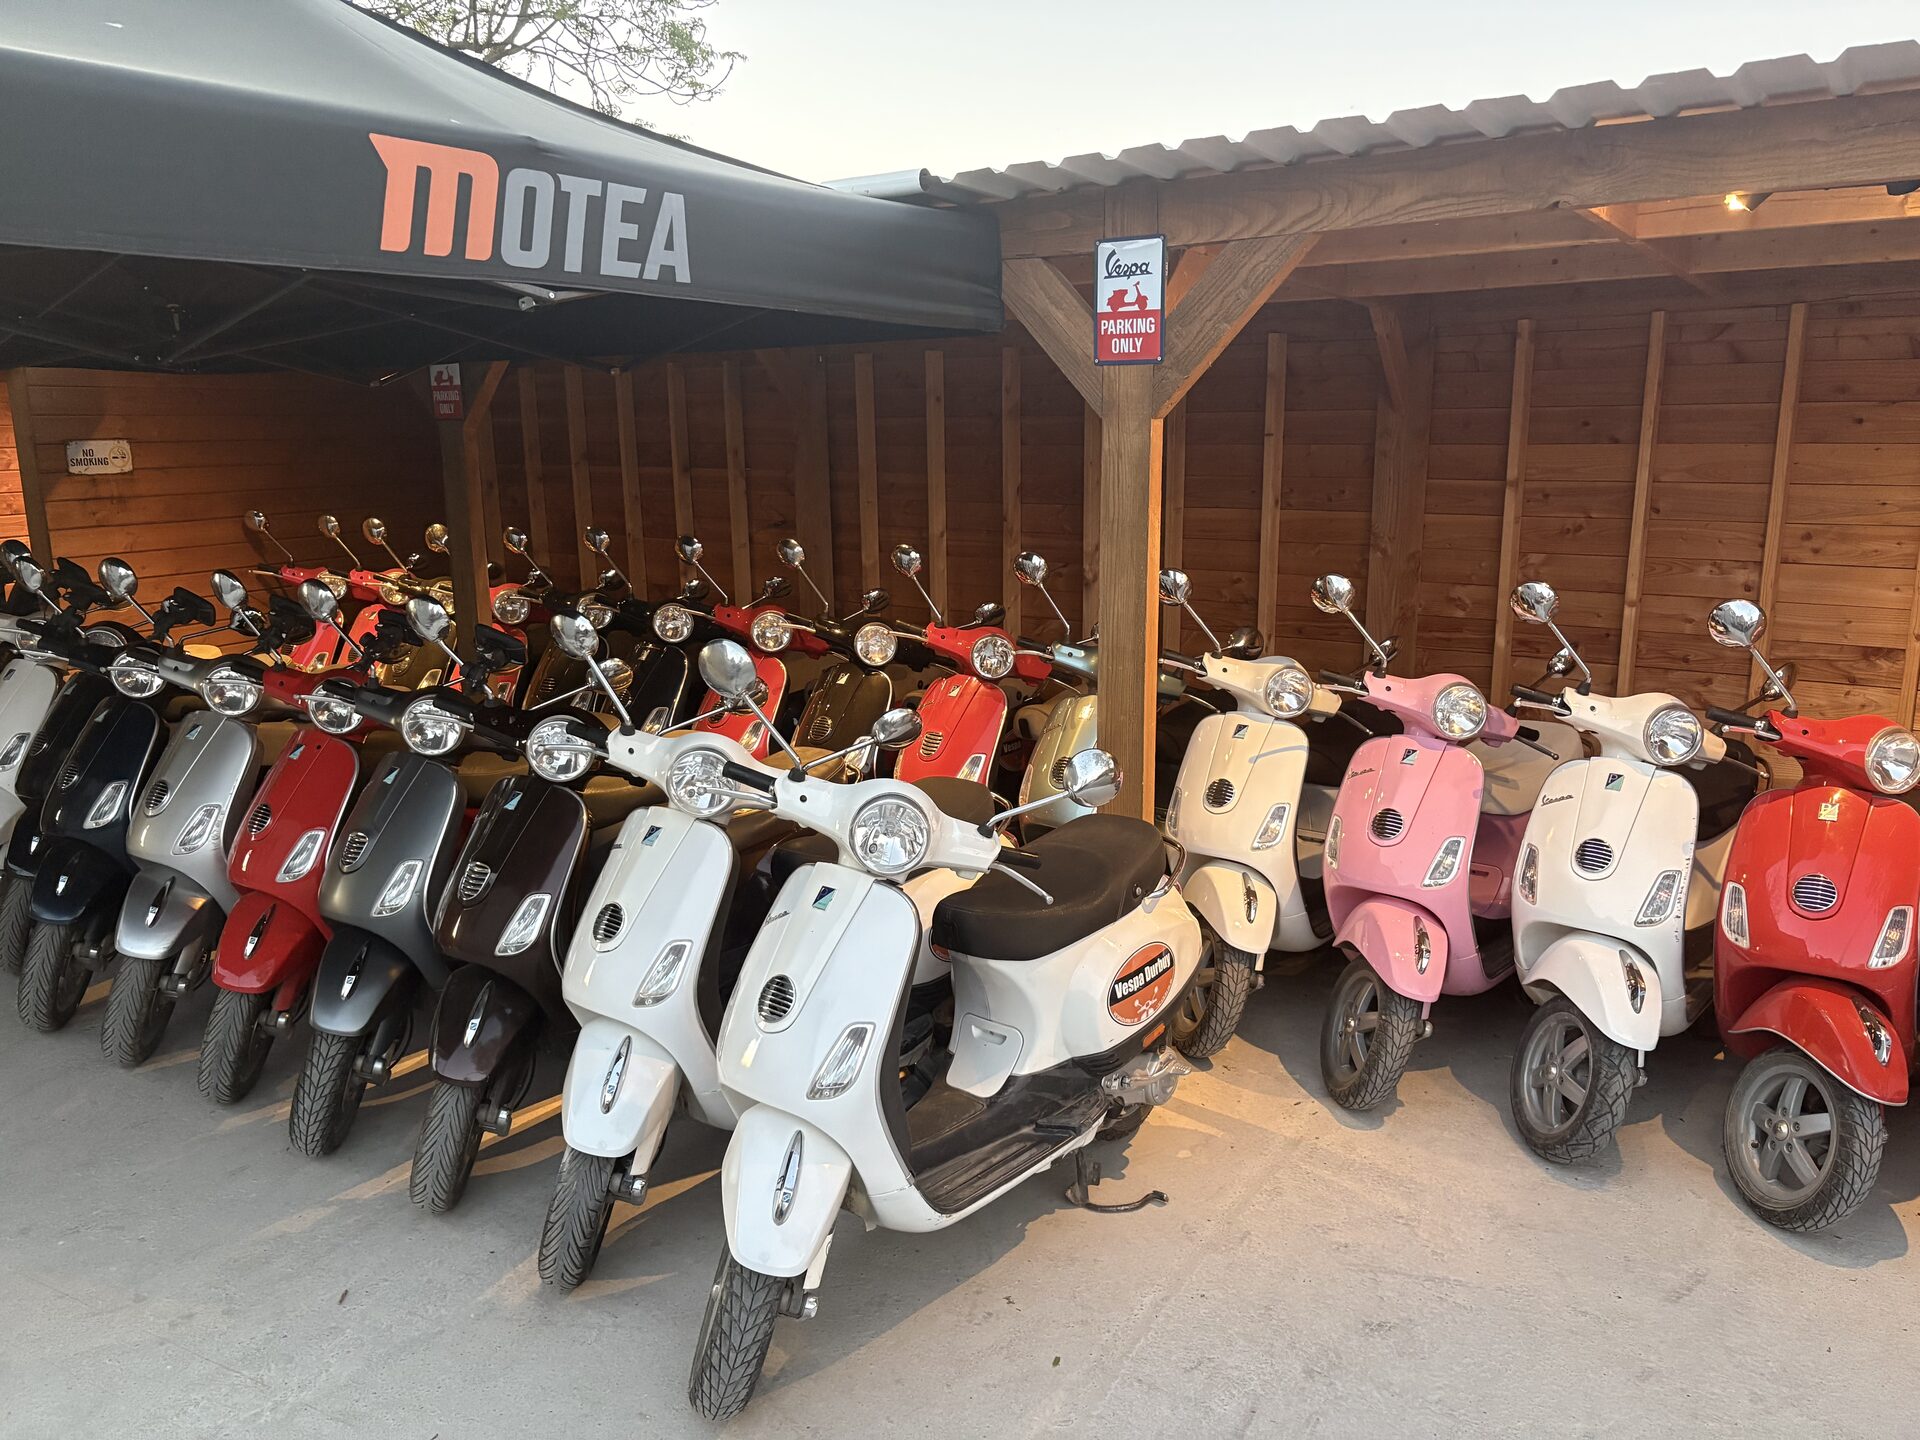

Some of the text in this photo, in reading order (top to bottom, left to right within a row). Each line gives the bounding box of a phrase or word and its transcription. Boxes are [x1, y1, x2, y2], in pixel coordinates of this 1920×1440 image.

[368, 132, 692, 284] MOTEA
[1104, 249, 1153, 280] Vespa
[1101, 317, 1156, 335] PARKING
[1111, 337, 1143, 354] ONLY
[70, 457, 109, 467] SMOKING
[82, 448, 94, 458] NO
[1114, 972, 1145, 999] Vespa
[1144, 952, 1171, 982] Durbuy
